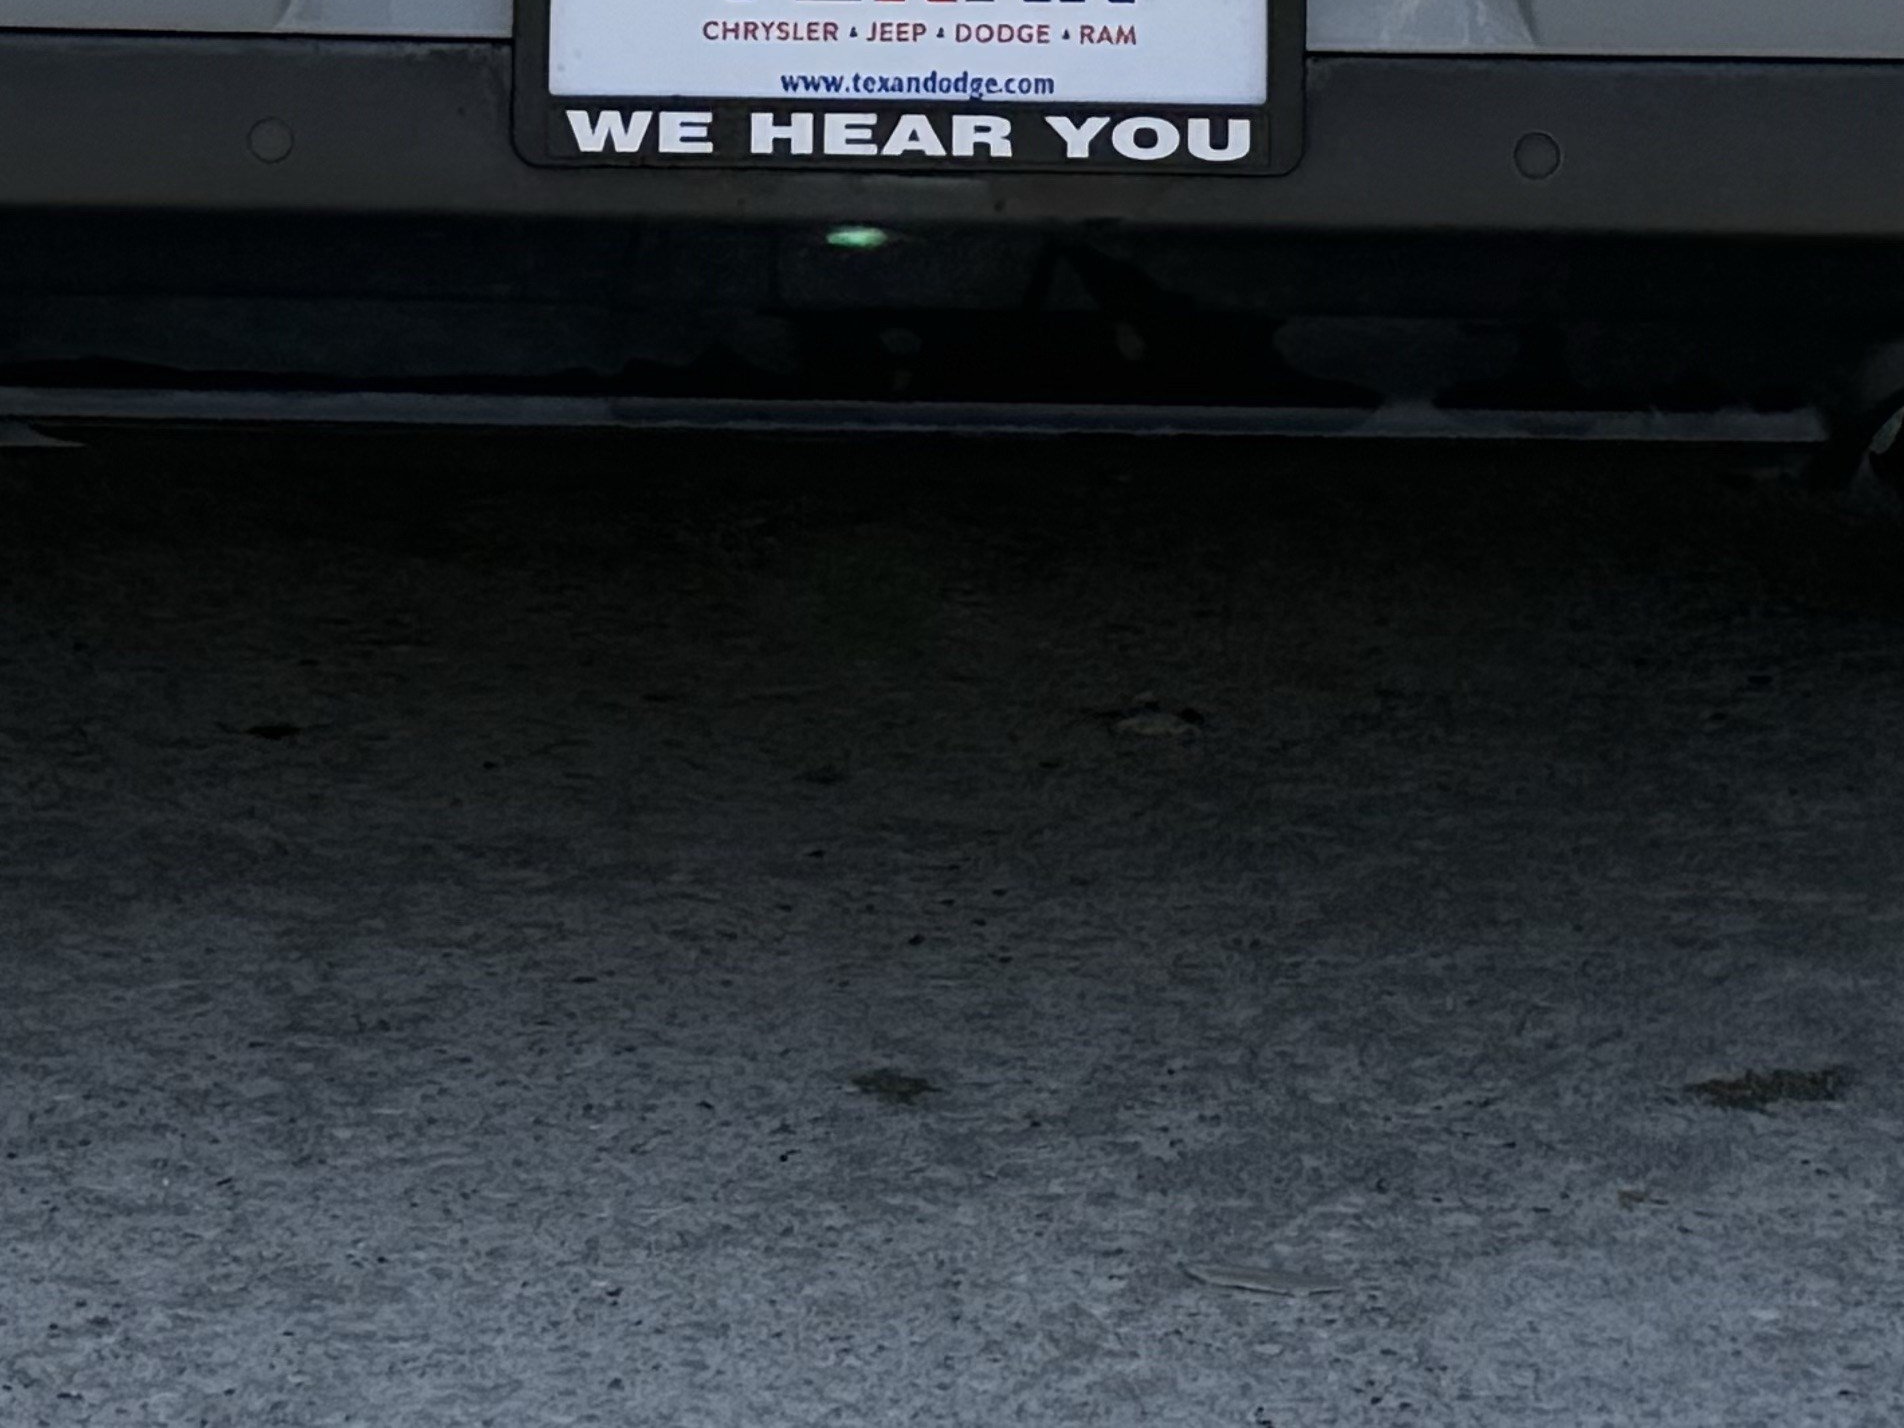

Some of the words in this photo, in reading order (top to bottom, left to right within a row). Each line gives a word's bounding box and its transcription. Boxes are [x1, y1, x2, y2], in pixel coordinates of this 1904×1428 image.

[702, 20, 839, 42] CHRYSLER
[865, 22, 927, 43] JEEP
[954, 23, 1051, 44] DODGE
[1079, 24, 1137, 45] RAM
[780, 70, 1055, 100] www.texandodge.com
[566, 109, 714, 154] WE
[749, 111, 1013, 158] HEAR
[1044, 116, 1252, 162] YOU
